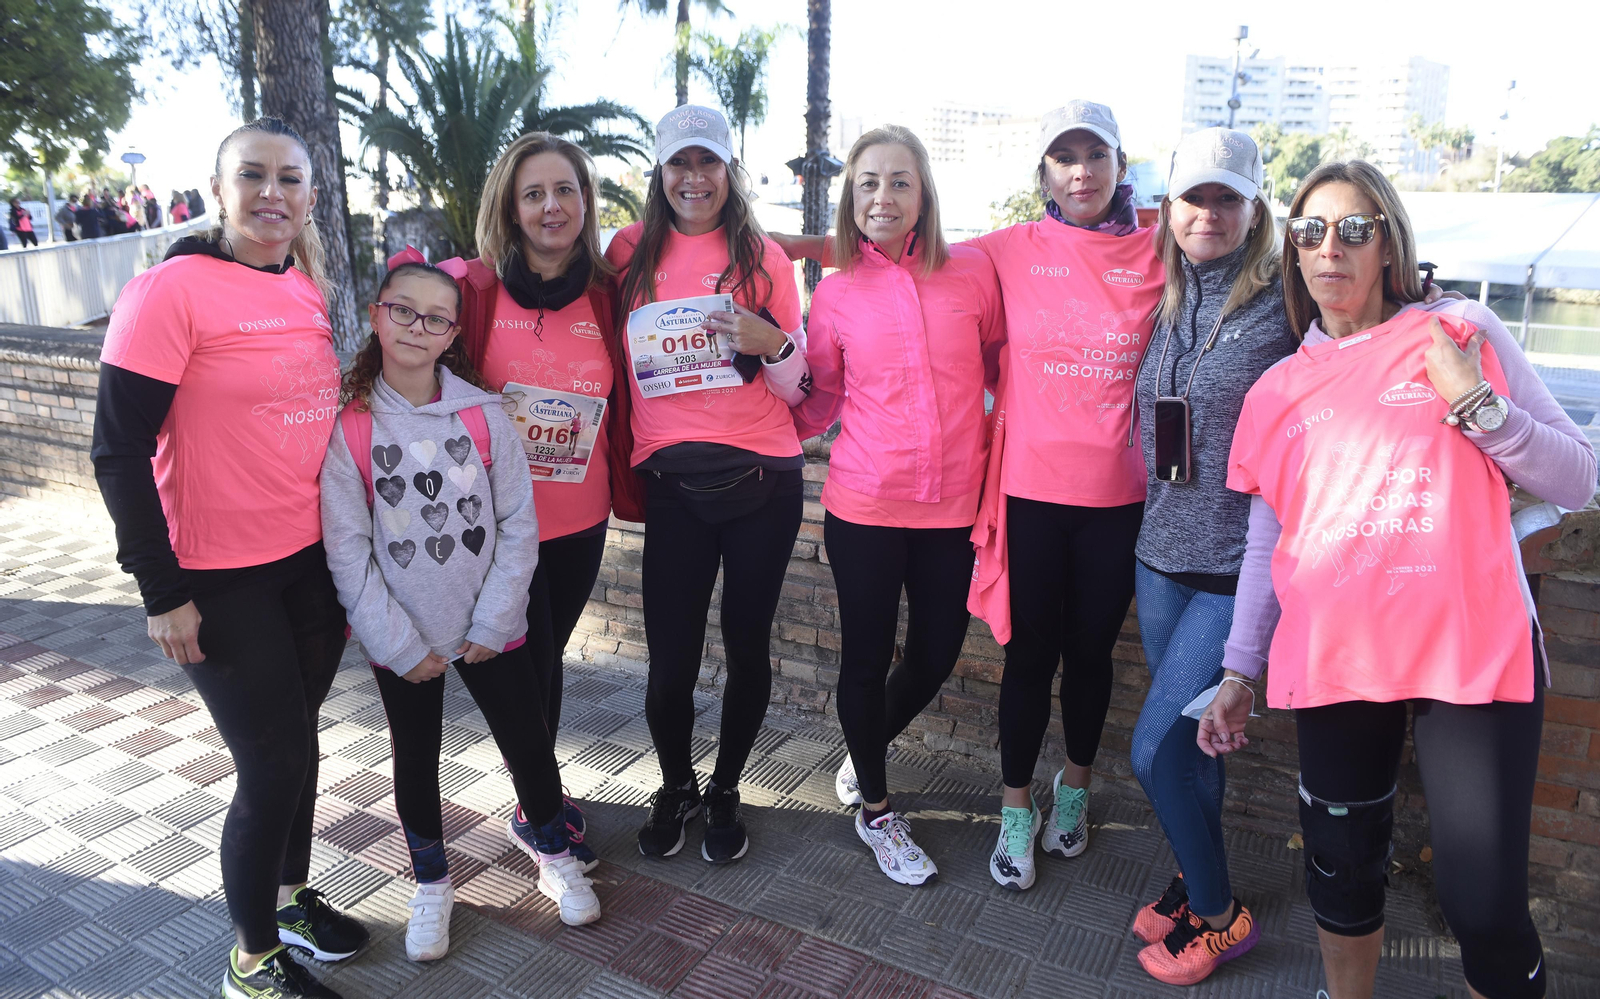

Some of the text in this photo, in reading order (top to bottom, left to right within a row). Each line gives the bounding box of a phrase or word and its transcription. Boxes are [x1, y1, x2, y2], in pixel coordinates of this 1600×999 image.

[669, 109, 716, 123] MAREA ROSA
[1030, 264, 1070, 277] OYSHO
[1105, 274, 1142, 284] ASTURIANA
[239, 317, 286, 333] OYSHO
[660, 316, 703, 328] ASTURIANA
[662, 333, 706, 354] 016
[1106, 332, 1140, 345] POR
[674, 354, 697, 364] 1203
[1081, 348, 1138, 363] TODAS
[653, 366, 681, 376] CARRERA
[700, 360, 722, 369] MUJER
[1043, 362, 1134, 381] NOSOTRAS
[573, 381, 602, 393] POR
[643, 380, 671, 392] OYSHO
[318, 387, 340, 401] TOD
[1383, 392, 1434, 403] ASTURIANA
[283, 406, 338, 426] NOSOTR
[533, 404, 573, 418] ASTURIANA
[1287, 408, 1334, 439] OYSHO
[527, 425, 569, 445] 016
[535, 445, 556, 456] 1232
[1385, 467, 1432, 486] POR
[1360, 491, 1433, 512] TODAS
[1321, 516, 1434, 544] NOSOTRAS
[1414, 564, 1437, 573] 2021
